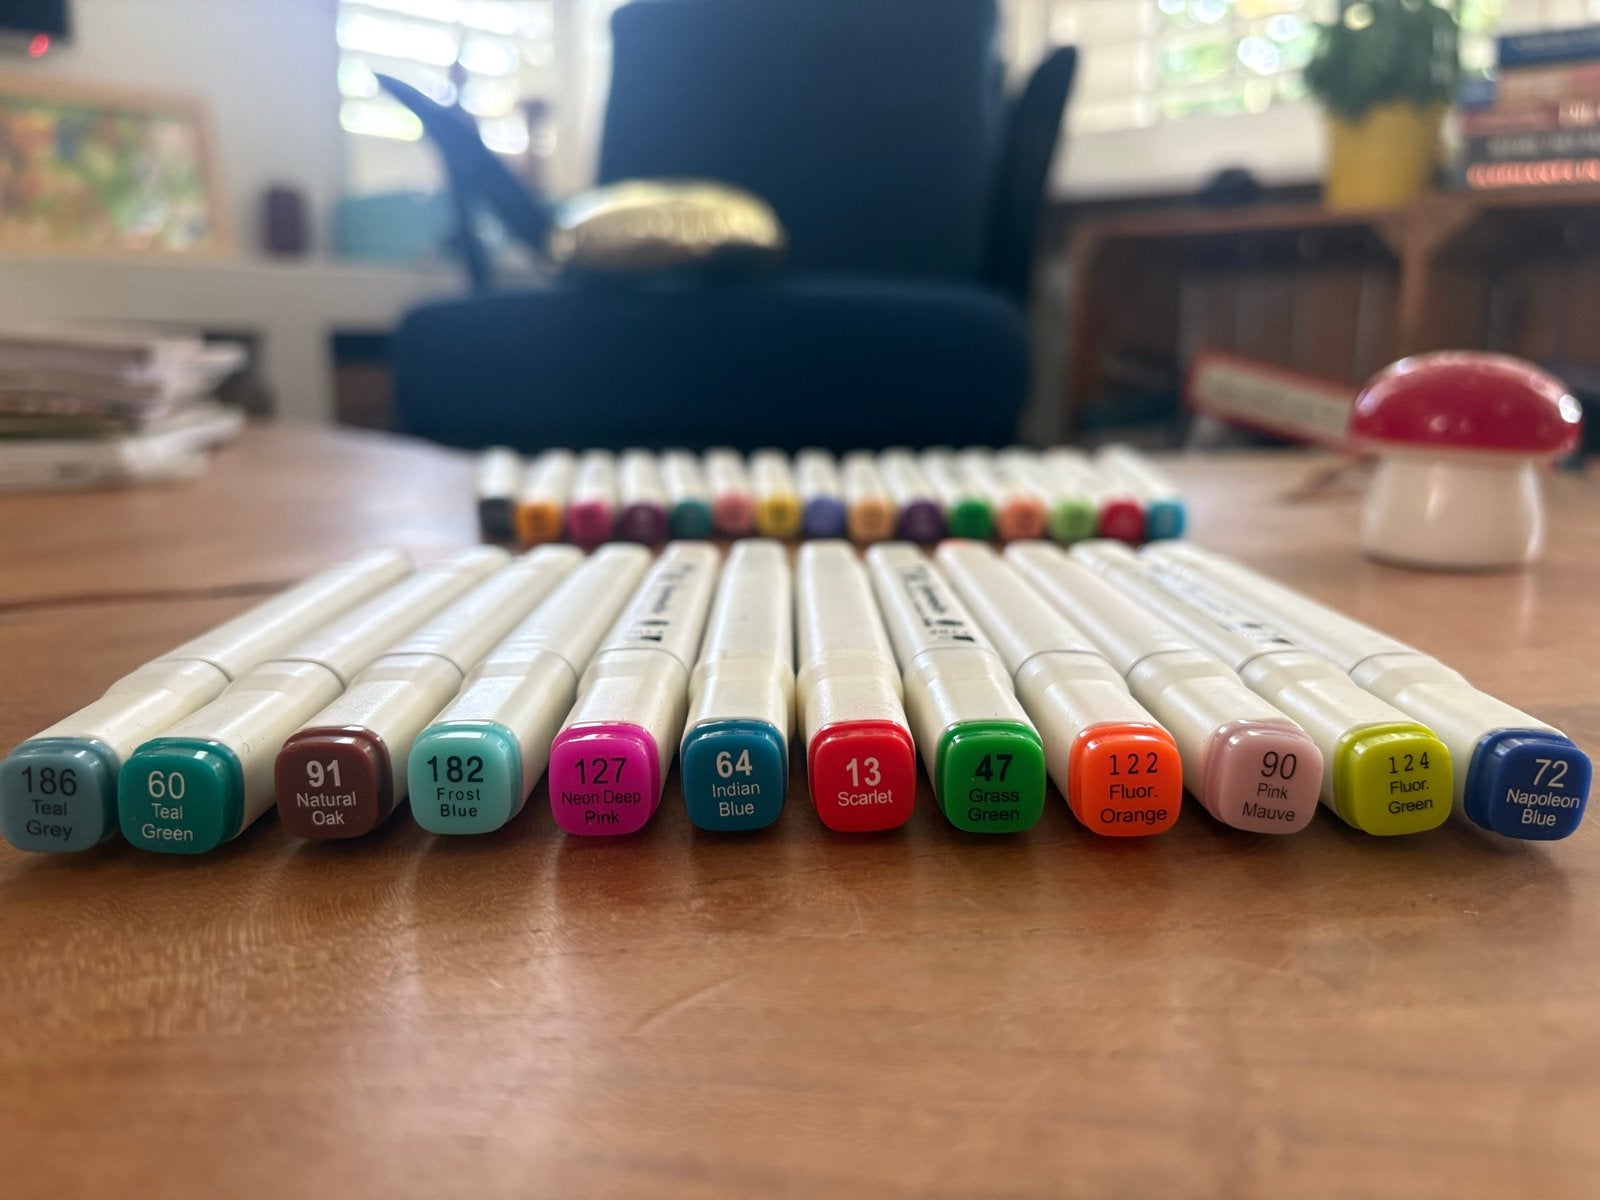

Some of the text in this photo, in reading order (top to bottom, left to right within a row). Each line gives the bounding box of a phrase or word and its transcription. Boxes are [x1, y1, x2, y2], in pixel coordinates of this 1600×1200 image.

[427, 755, 484, 783] 182
[574, 757, 627, 785] 127
[715, 749, 752, 778] 64
[845, 756, 882, 787] 13
[975, 754, 1013, 782] 47
[1260, 751, 1297, 780] 90
[21, 765, 77, 796] 186
[306, 759, 342, 788] 91
[1532, 758, 1569, 788] 72
[148, 770, 185, 800] 60
[712, 782, 760, 798] Indian
[1109, 784, 1158, 800] Fluor.
[1256, 782, 1289, 800] Pink
[1389, 779, 1429, 794] Fluor.
[296, 791, 357, 808] Natural
[436, 787, 481, 801] Frost
[561, 790, 641, 806] Neon Deep
[837, 789, 893, 807] Scarlet
[968, 788, 1020, 803] Grass
[1505, 788, 1580, 809] Napoleon
[31, 799, 67, 816] Teal
[151, 803, 183, 820] Teal
[440, 804, 478, 818] Blue
[718, 802, 755, 817] Blue
[967, 807, 1020, 821] Green
[1242, 801, 1295, 822] Mauve
[1388, 798, 1433, 814] Green
[312, 810, 345, 826] Oak
[584, 810, 620, 825] Pink
[1100, 807, 1167, 825] Orange
[1521, 809, 1556, 826] Blue
[26, 819, 73, 841] Grey
[141, 824, 194, 841] Green
